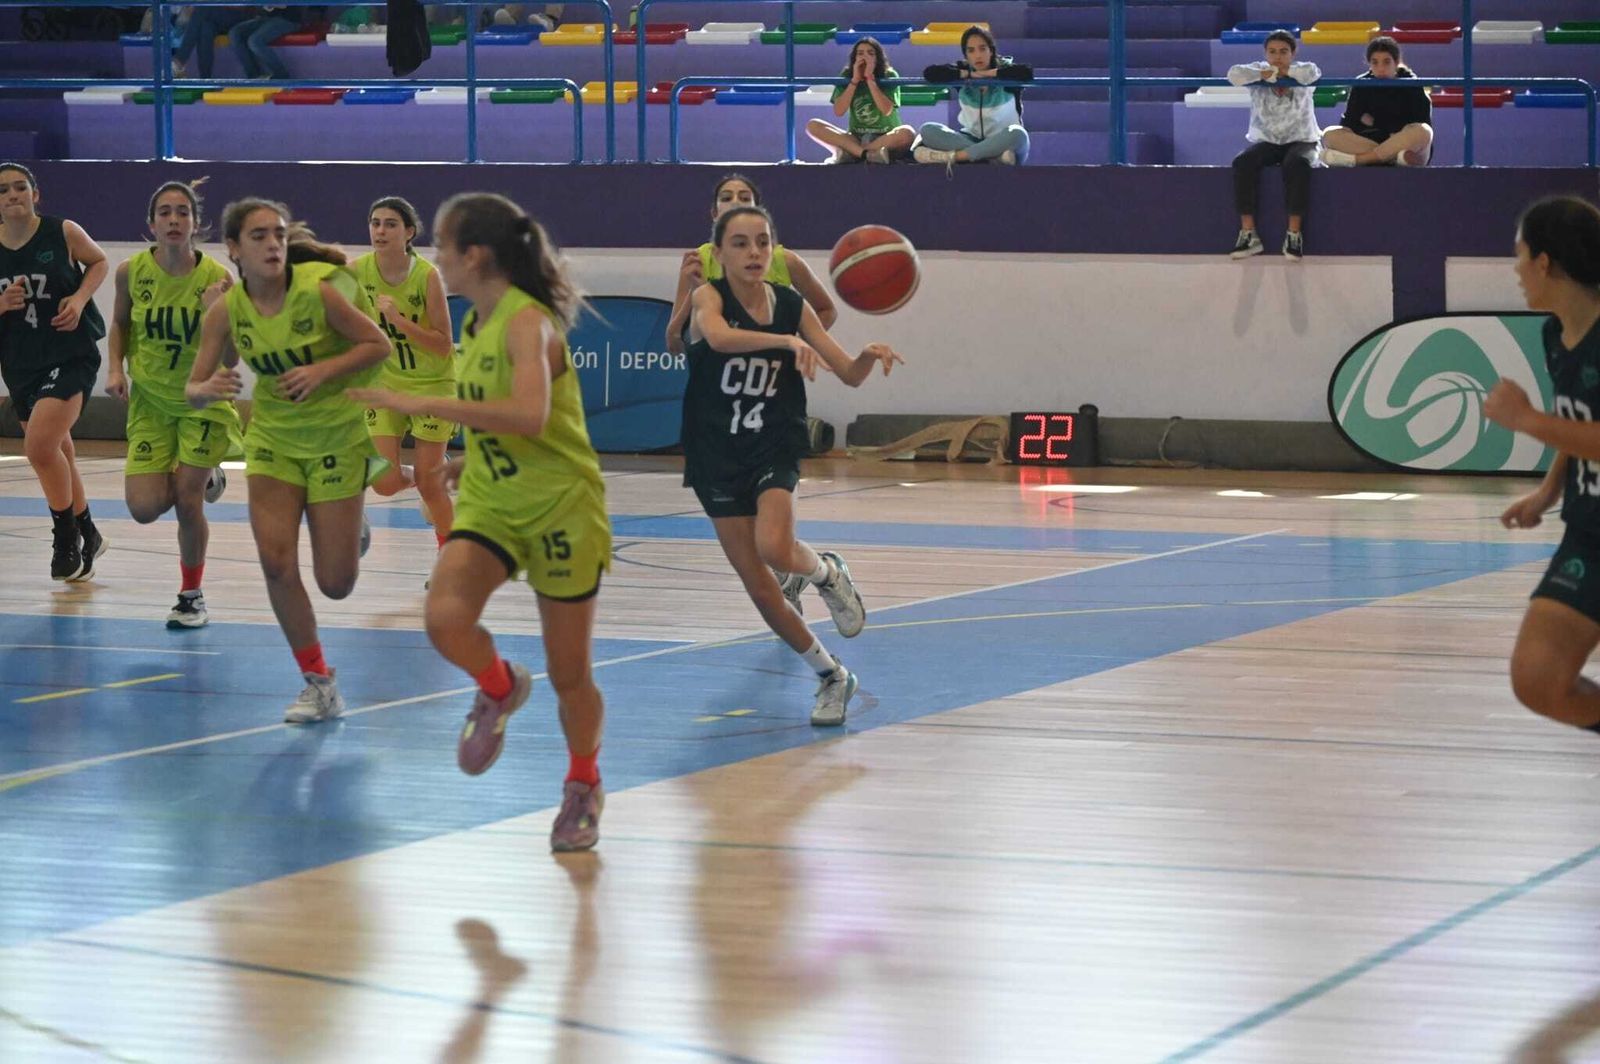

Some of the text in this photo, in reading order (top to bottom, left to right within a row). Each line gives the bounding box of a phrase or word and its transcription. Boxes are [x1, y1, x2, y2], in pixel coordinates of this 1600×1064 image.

[25, 303, 38, 329] 4
[145, 305, 201, 345] HLV
[165, 344, 182, 370] 7
[396, 341, 416, 370] 11
[620, 351, 686, 370] DEPOR
[720, 357, 783, 397] CDZ
[200, 420, 211, 441] 7
[730, 400, 765, 434] 14
[1019, 414, 1073, 460] 22
[477, 437, 519, 481] 15
[541, 530, 572, 562] 15
